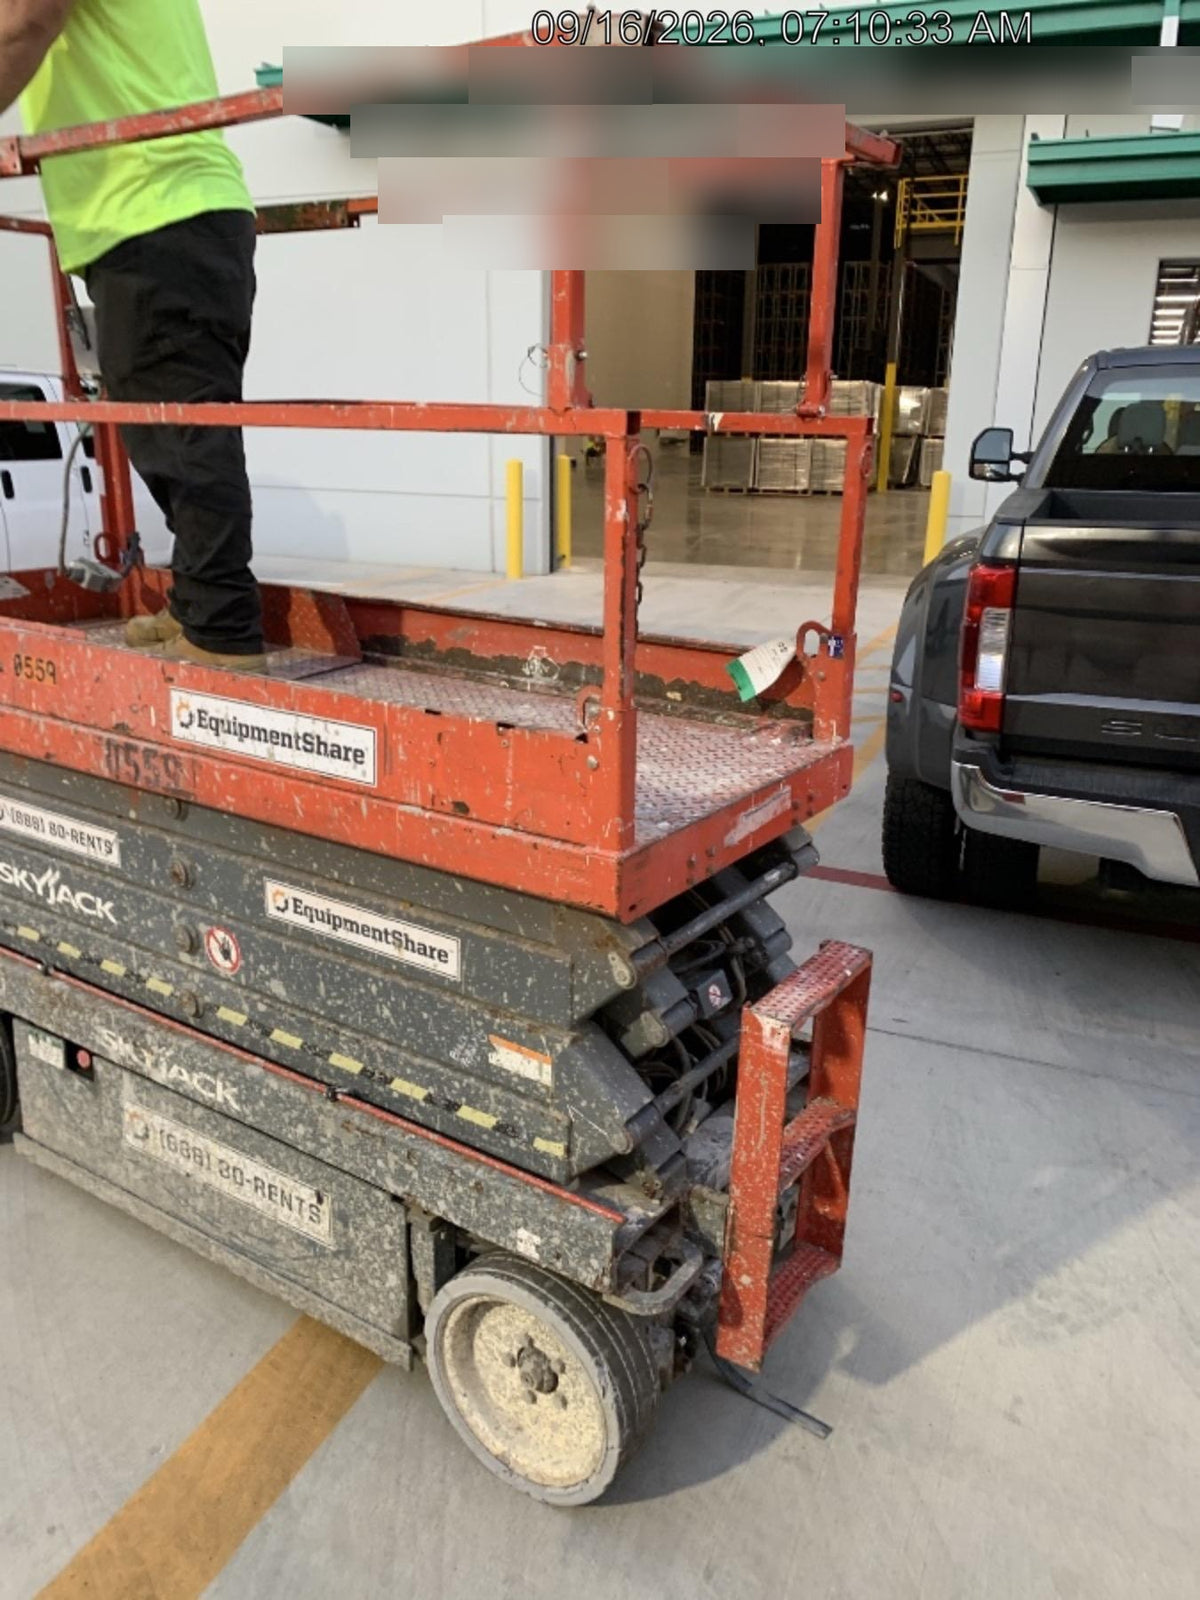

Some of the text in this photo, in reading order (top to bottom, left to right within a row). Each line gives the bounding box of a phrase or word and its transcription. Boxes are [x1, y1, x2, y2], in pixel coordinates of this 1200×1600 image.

[14, 653, 57, 685] 0559
[197, 708, 366, 765] EquipmentShare
[49, 821, 114, 855] 80-RENTS
[0, 861, 118, 925] SKYJACK
[292, 897, 449, 964] EquipmentShare
